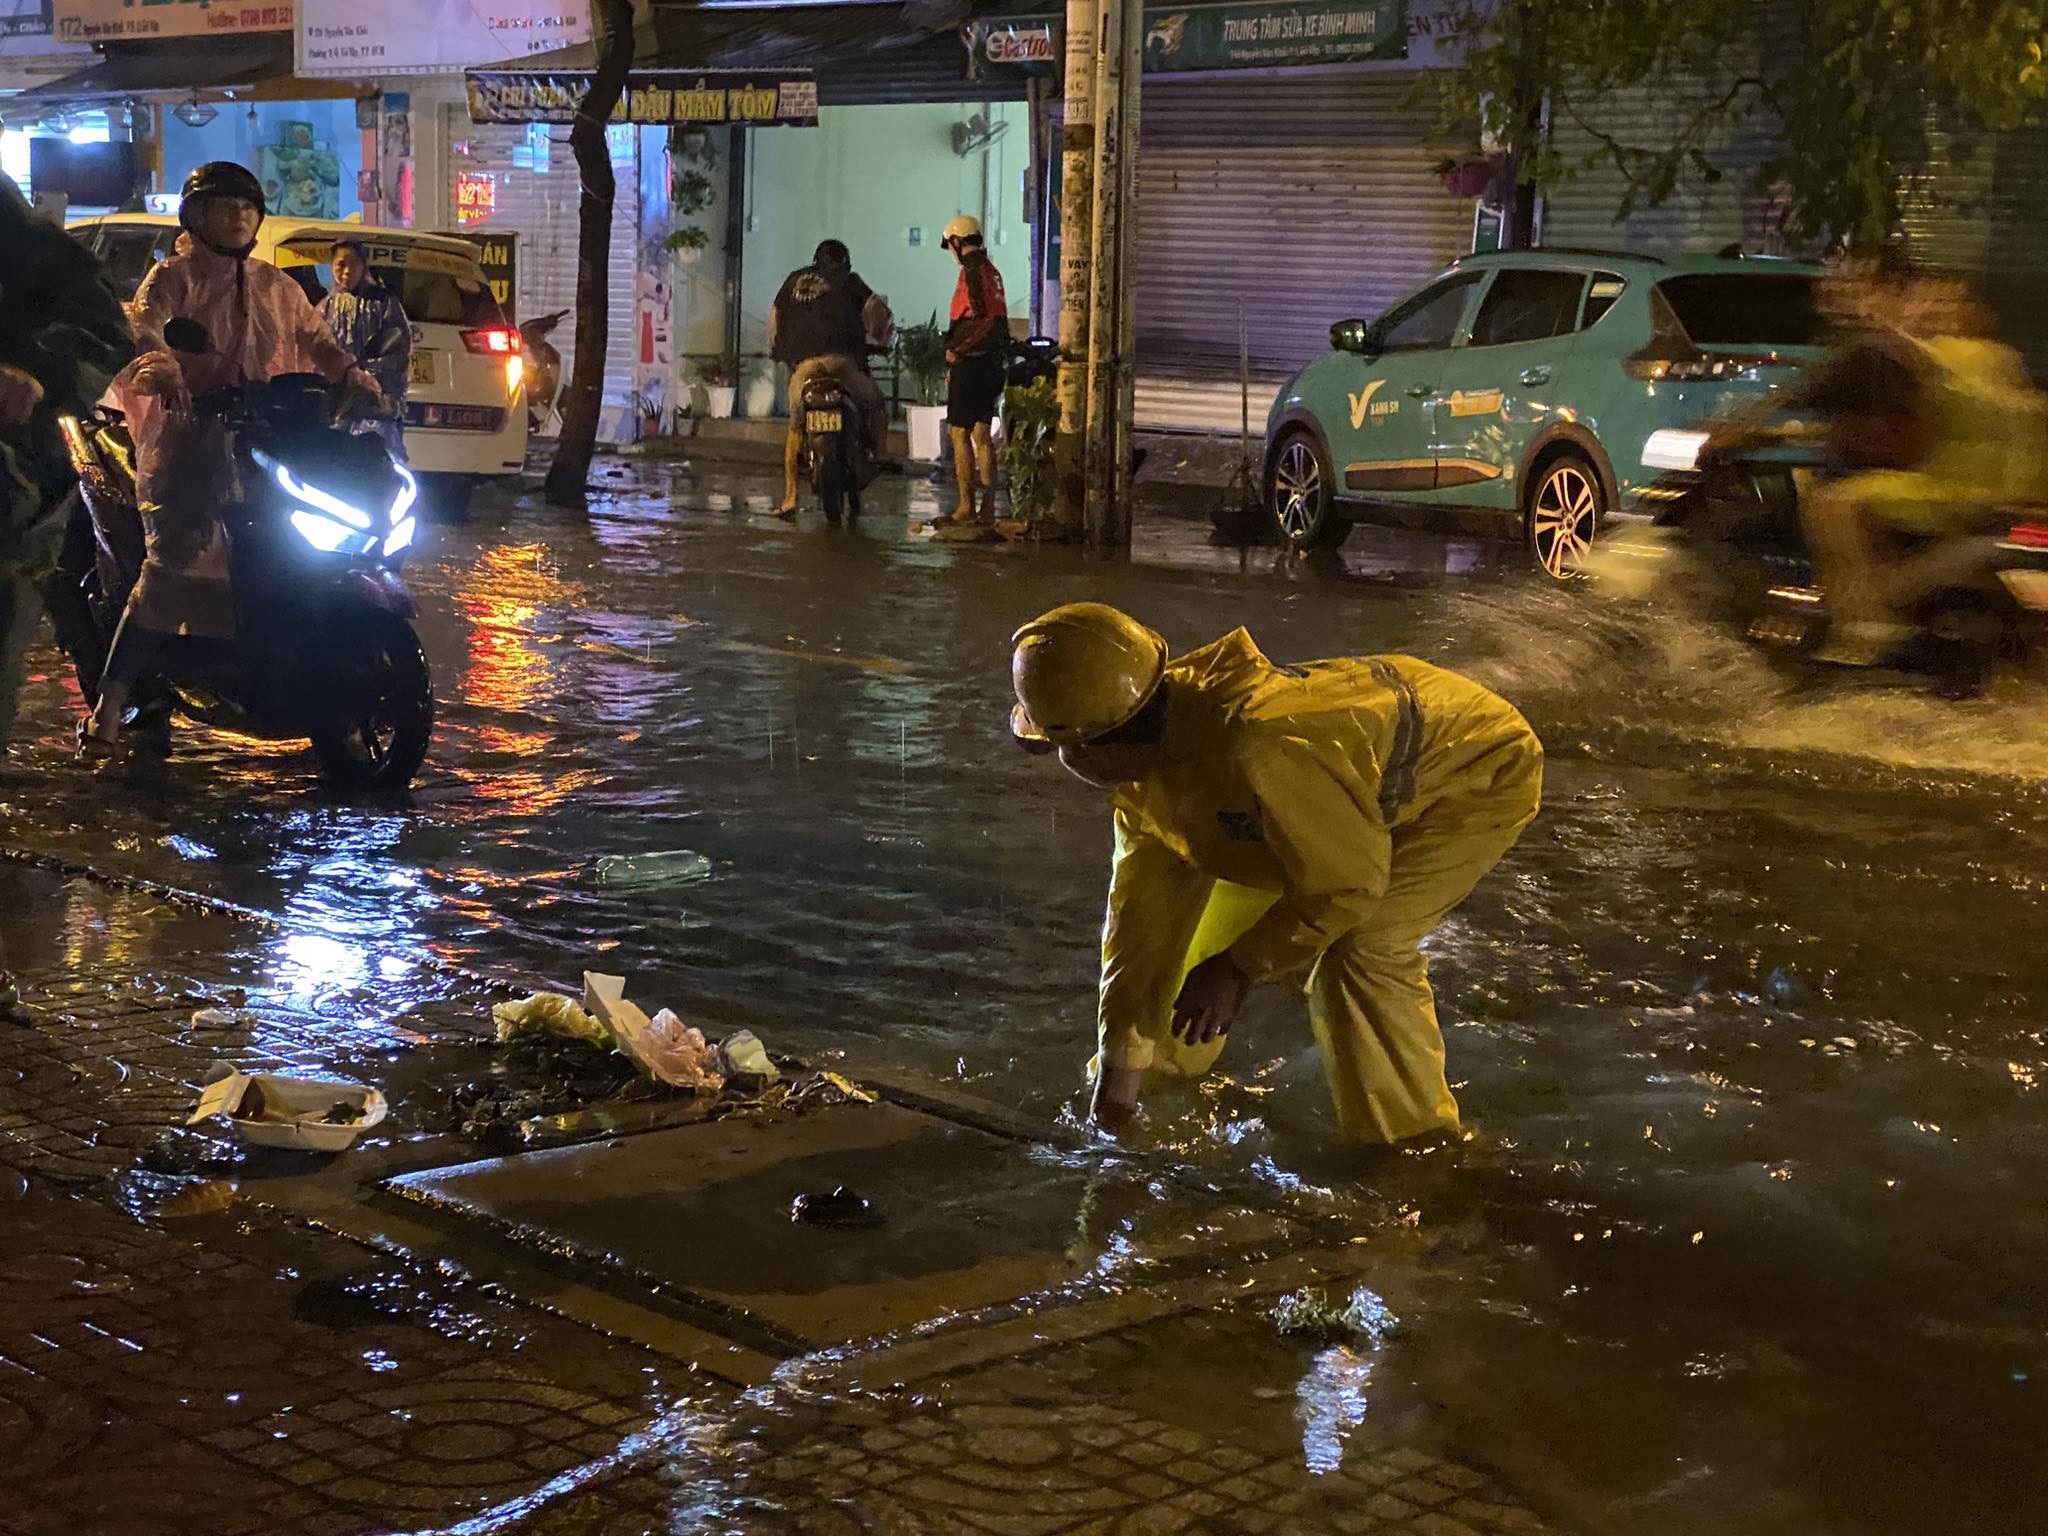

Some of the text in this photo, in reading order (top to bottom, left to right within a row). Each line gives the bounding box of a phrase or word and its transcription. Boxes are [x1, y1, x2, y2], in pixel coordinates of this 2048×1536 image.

[59, 16, 82, 39] 172
[1224, 18, 1258, 41] TRUNG
[1259, 13, 1281, 40] TÂM
[1304, 15, 1318, 38] XE
[1318, 9, 1345, 36] BÌNH
[1345, 11, 1376, 35] MINH
[728, 82, 778, 120] TÔM
